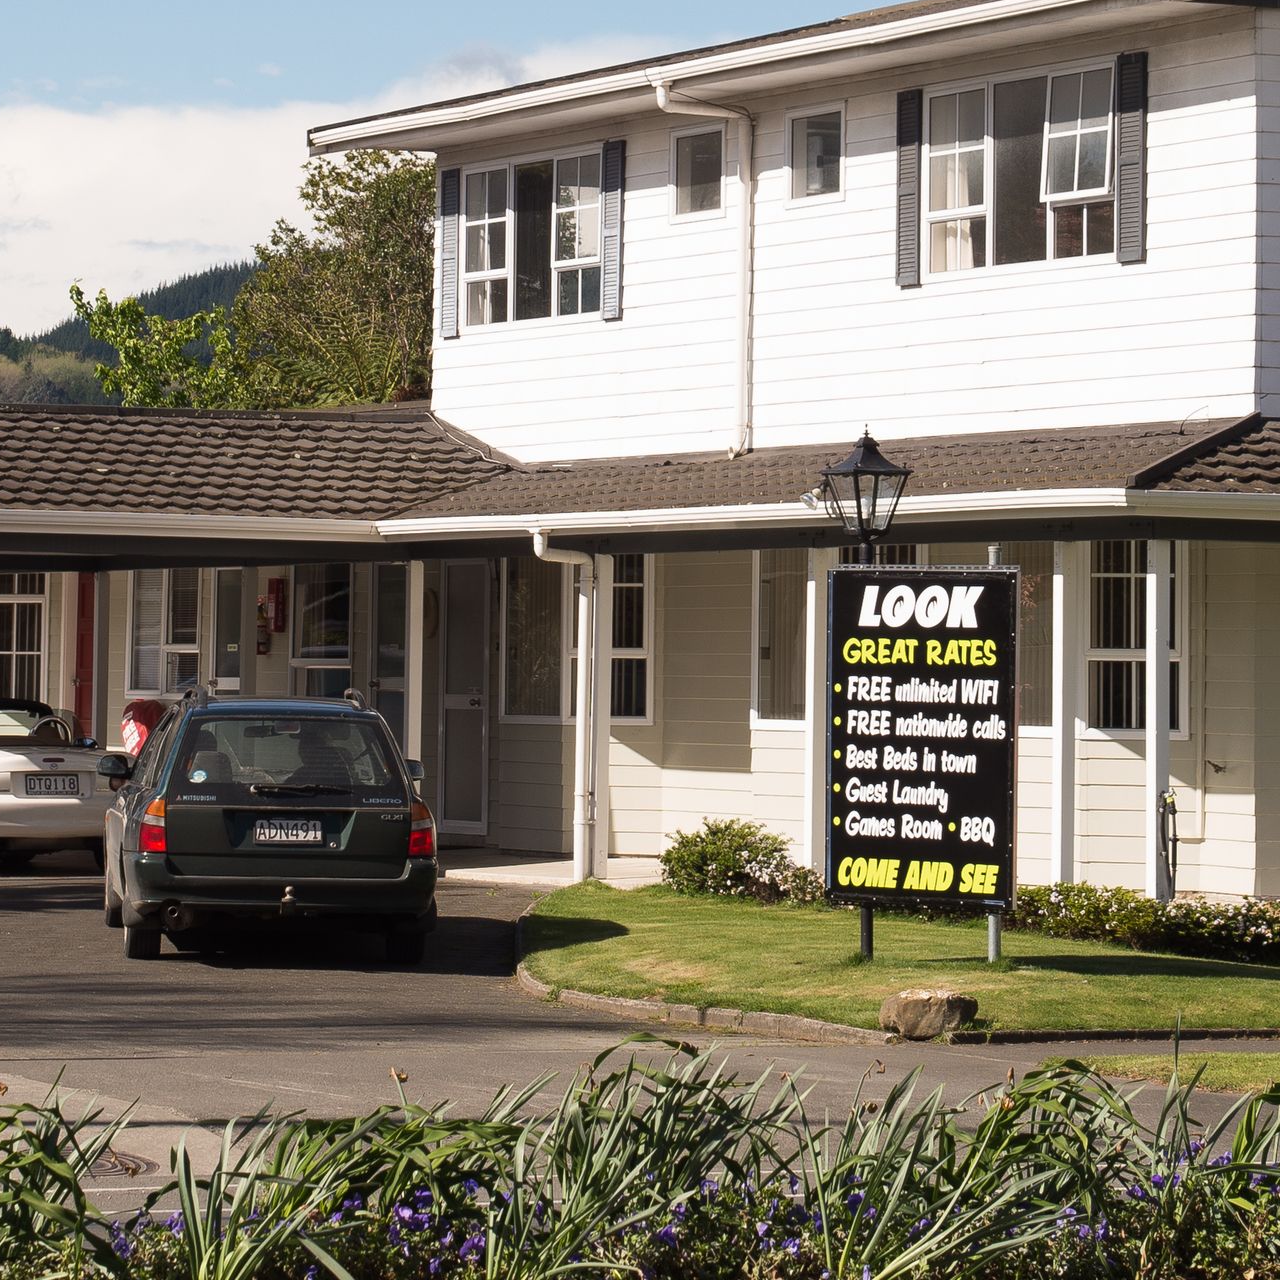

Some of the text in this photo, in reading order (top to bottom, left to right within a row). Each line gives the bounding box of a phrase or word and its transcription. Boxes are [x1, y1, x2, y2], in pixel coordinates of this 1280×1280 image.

[858, 584, 984, 628] LOOK
[842, 637, 997, 666] GREAT RATES
[847, 675, 999, 705] FREE unlimited WIFI
[846, 709, 1006, 740] FREE nationwide calls
[845, 743, 977, 774] Best Beds in town
[28, 777, 76, 790] DTQ118
[845, 777, 948, 813] Guest Laundry
[257, 822, 319, 840] ADN491
[845, 810, 995, 847] Games Room BBQ
[838, 856, 999, 895] COME AND SEE
